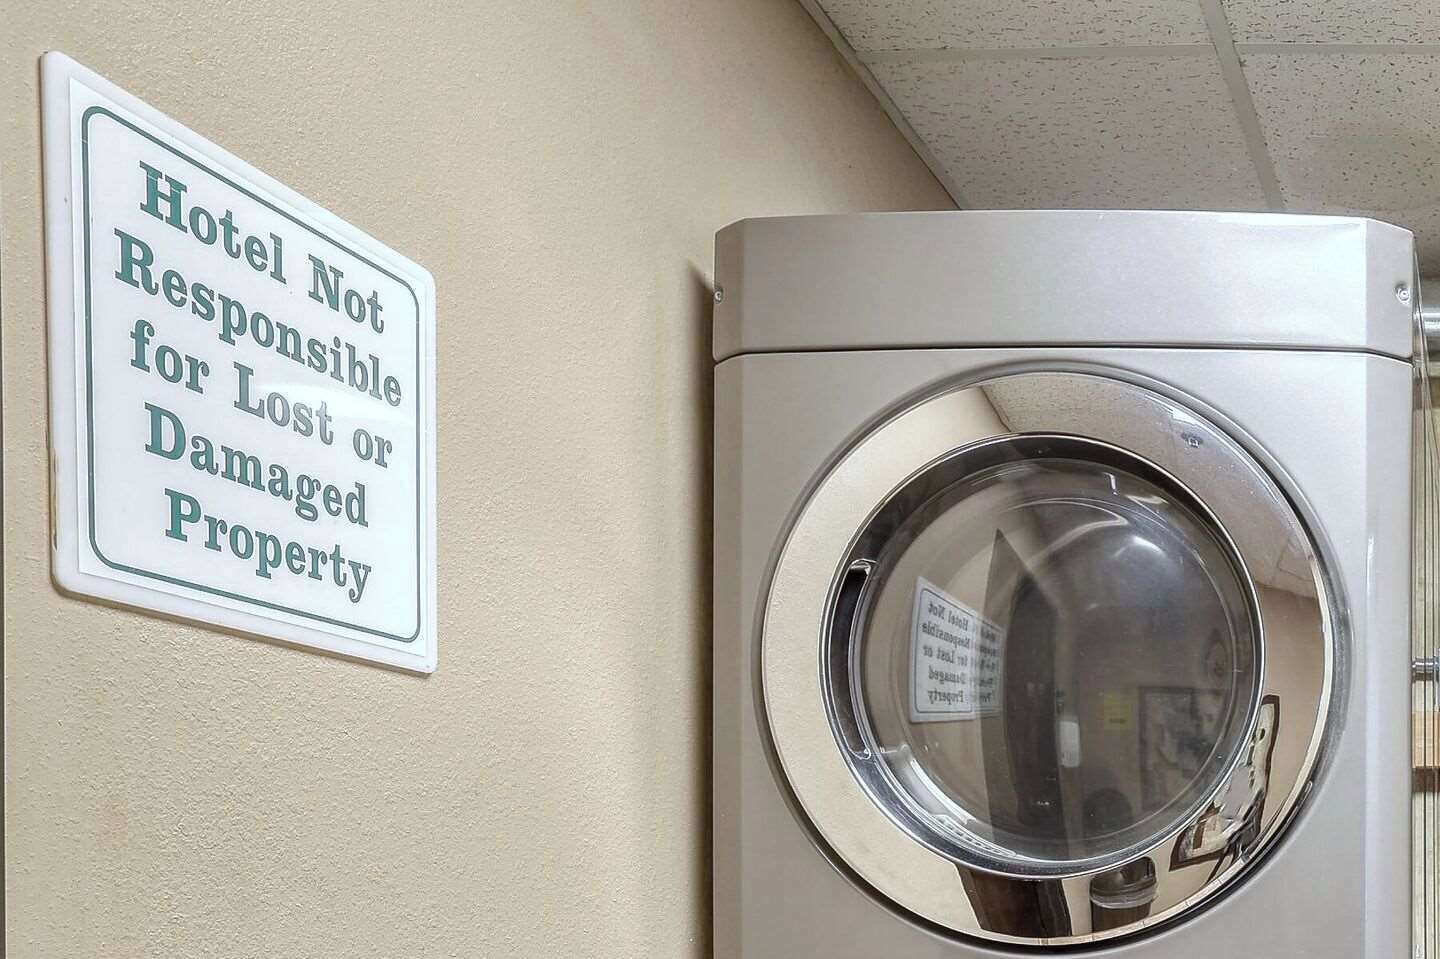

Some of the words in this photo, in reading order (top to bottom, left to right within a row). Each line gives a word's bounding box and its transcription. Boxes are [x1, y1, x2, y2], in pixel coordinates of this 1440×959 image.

[114, 228, 402, 407] Responsible
[139, 161, 286, 284] Hotel
[308, 254, 384, 333] Not
[130, 320, 209, 393] for
[234, 361, 334, 445] Lost
[353, 426, 393, 468] or
[145, 402, 369, 526] Damaged
[165, 488, 371, 603] Property
